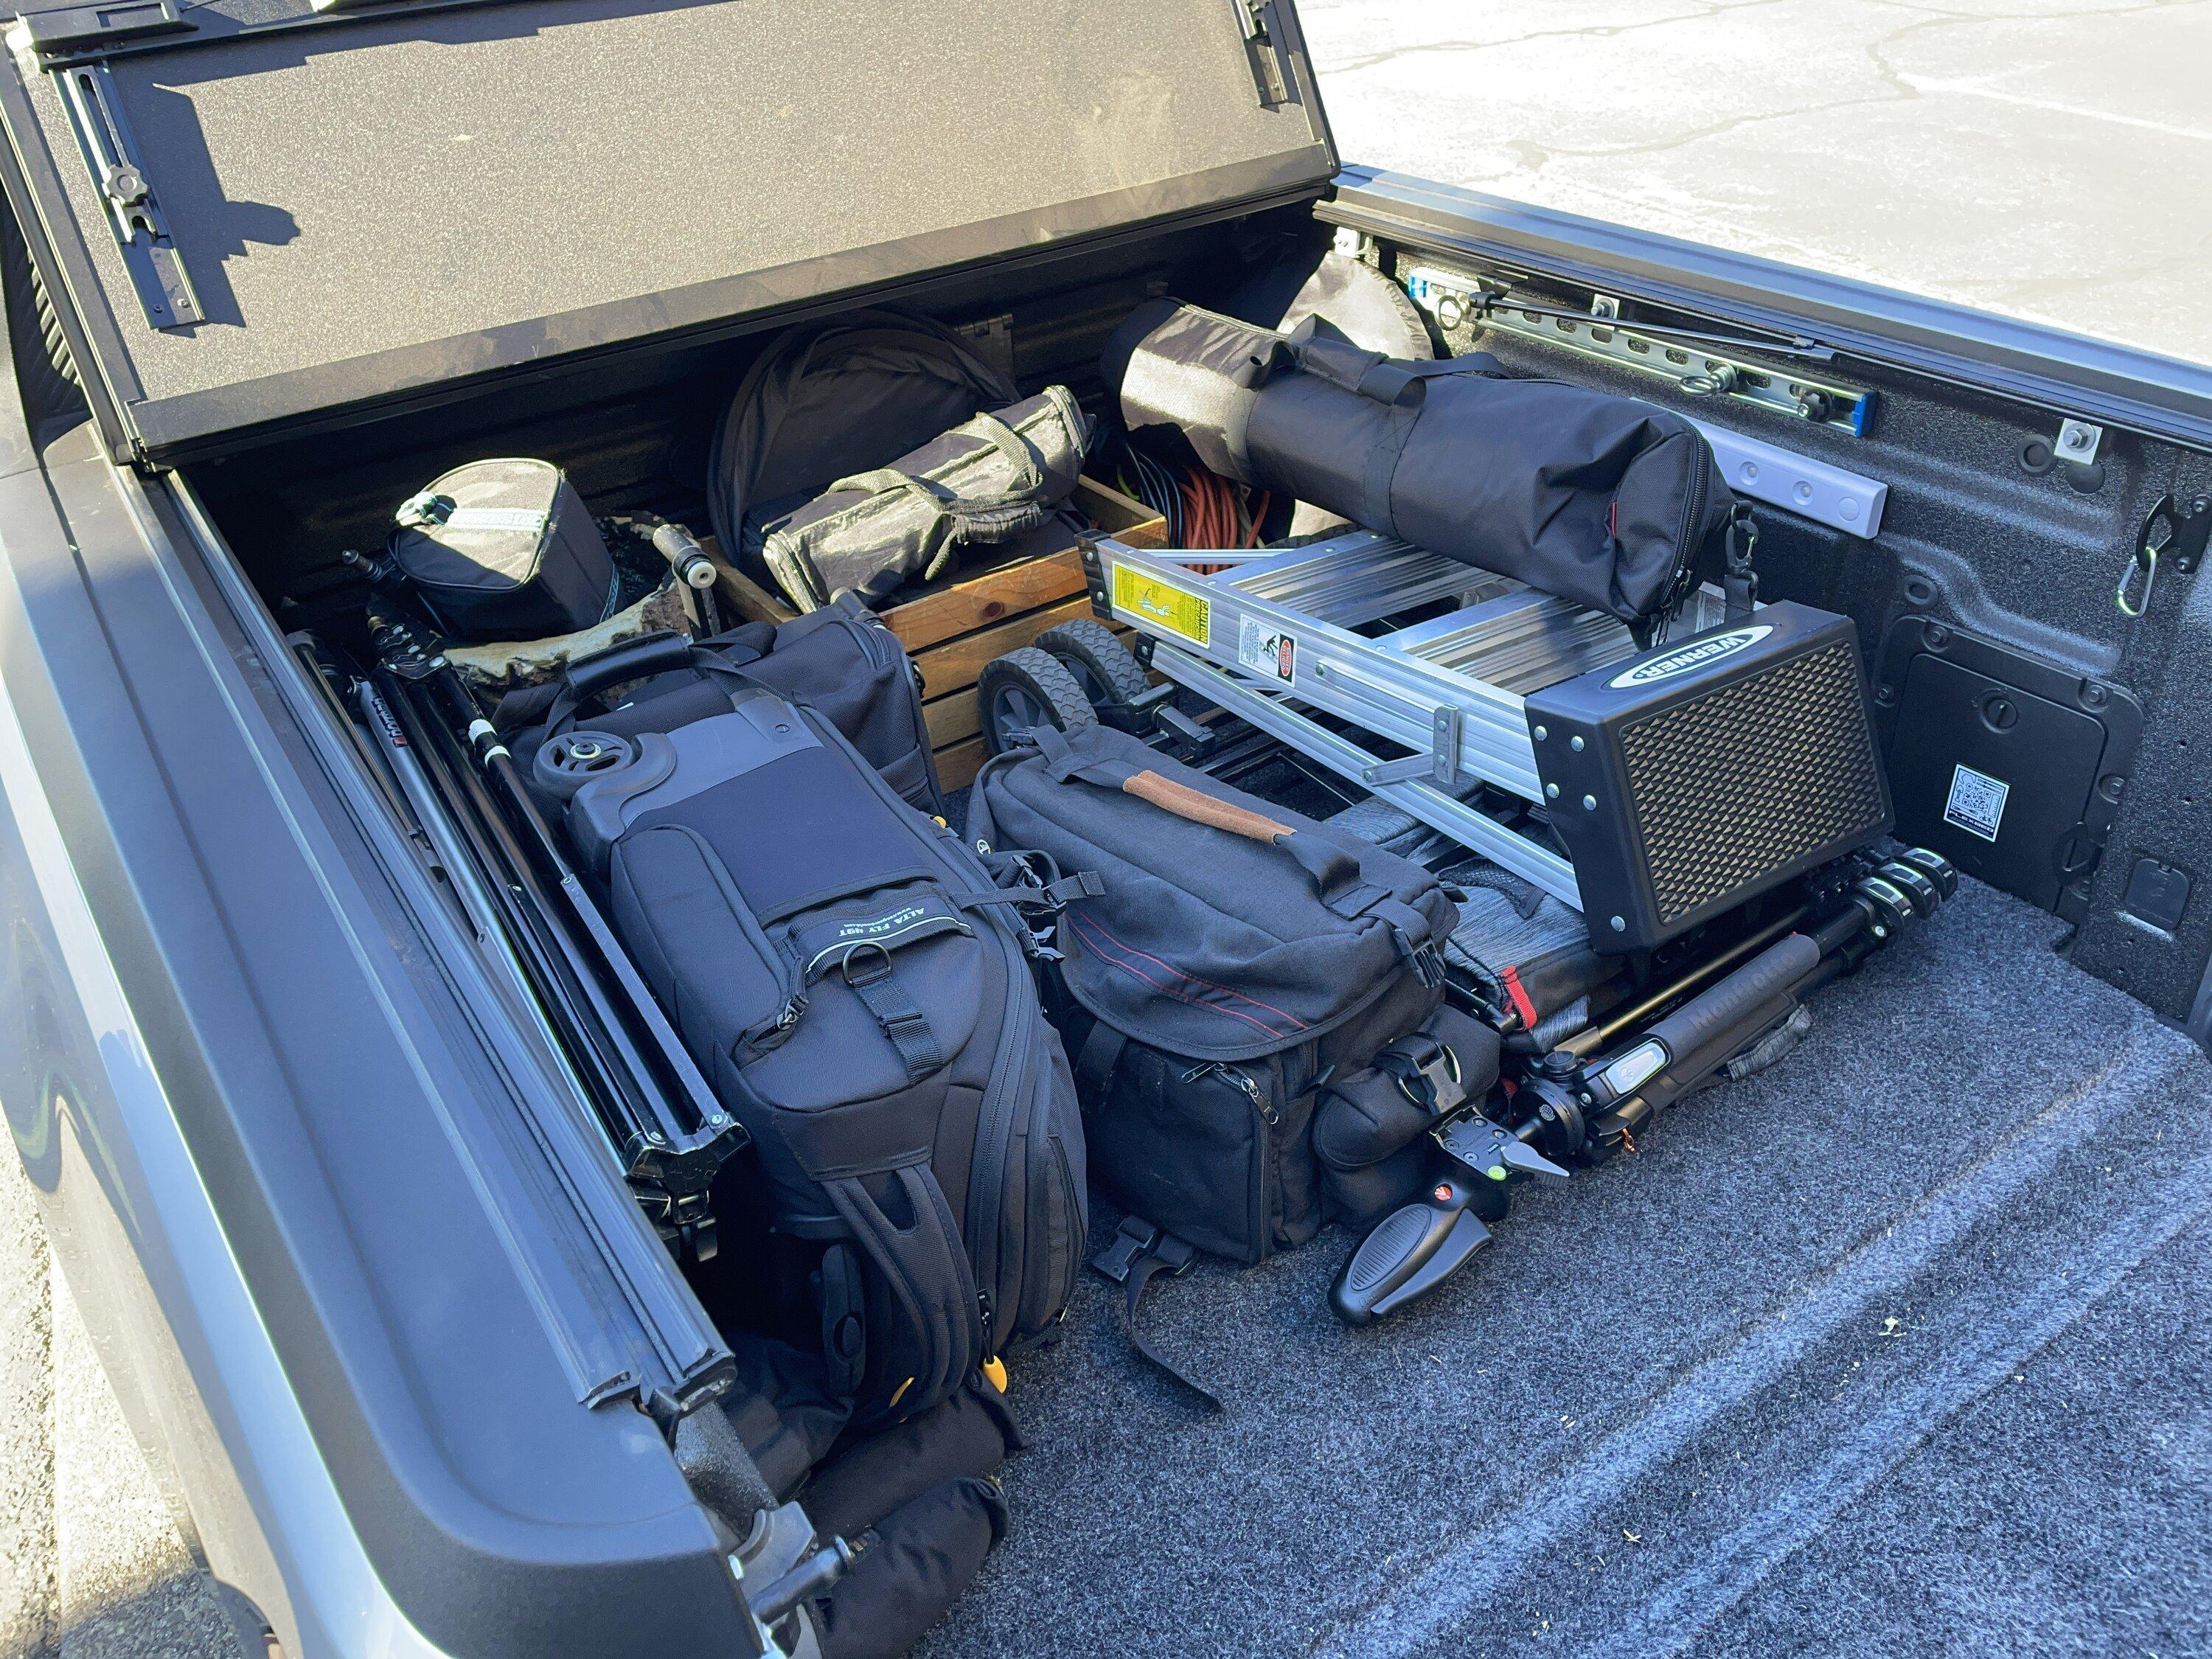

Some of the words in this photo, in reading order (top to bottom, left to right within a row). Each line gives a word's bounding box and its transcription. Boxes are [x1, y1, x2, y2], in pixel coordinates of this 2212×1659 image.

[1200, 600, 1208, 644] CAUTION
[1642, 636, 1745, 678] WERNER
[1948, 810, 1994, 833] FLEXBED
[894, 908, 925, 924] ALTA
[869, 923, 891, 933] FLY
